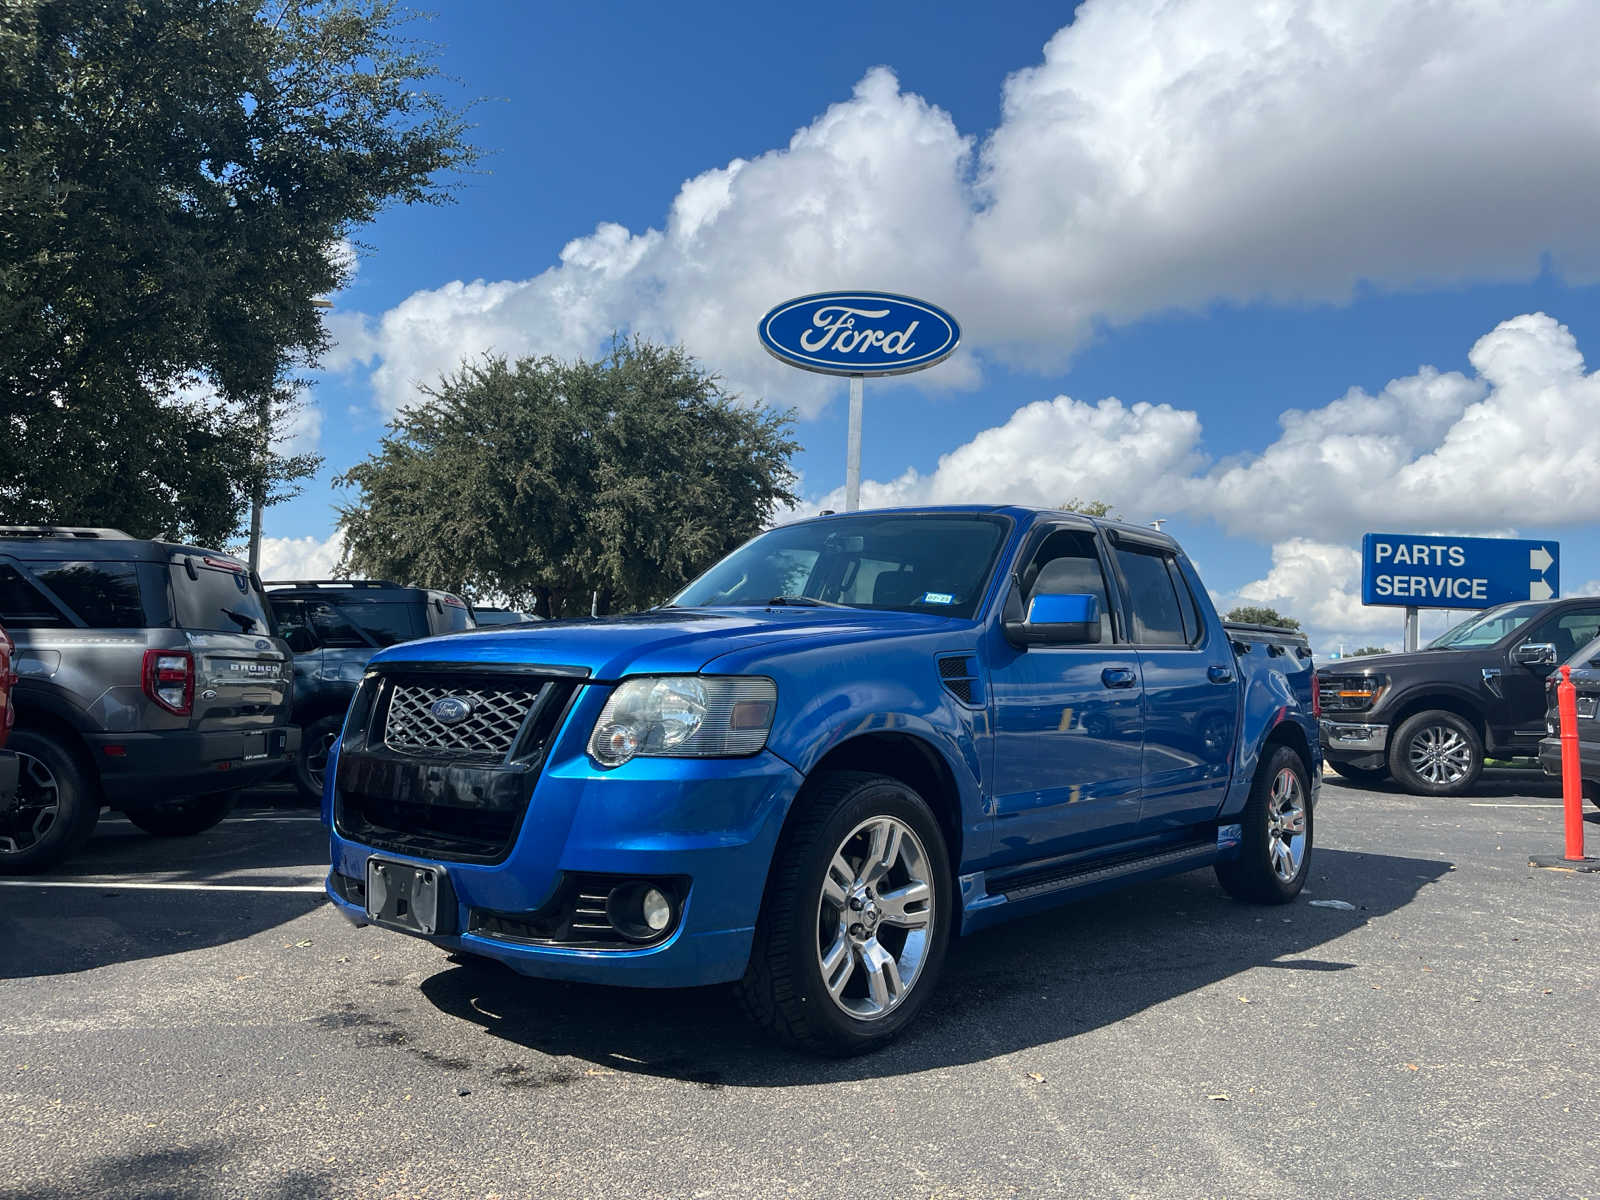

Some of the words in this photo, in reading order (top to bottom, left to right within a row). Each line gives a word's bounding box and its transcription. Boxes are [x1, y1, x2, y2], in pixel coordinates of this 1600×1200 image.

[800, 305, 920, 355] Ford
[1375, 543, 1465, 567] PARTS
[1375, 574, 1488, 600] SERVICE
[230, 663, 278, 672] BRONCO
